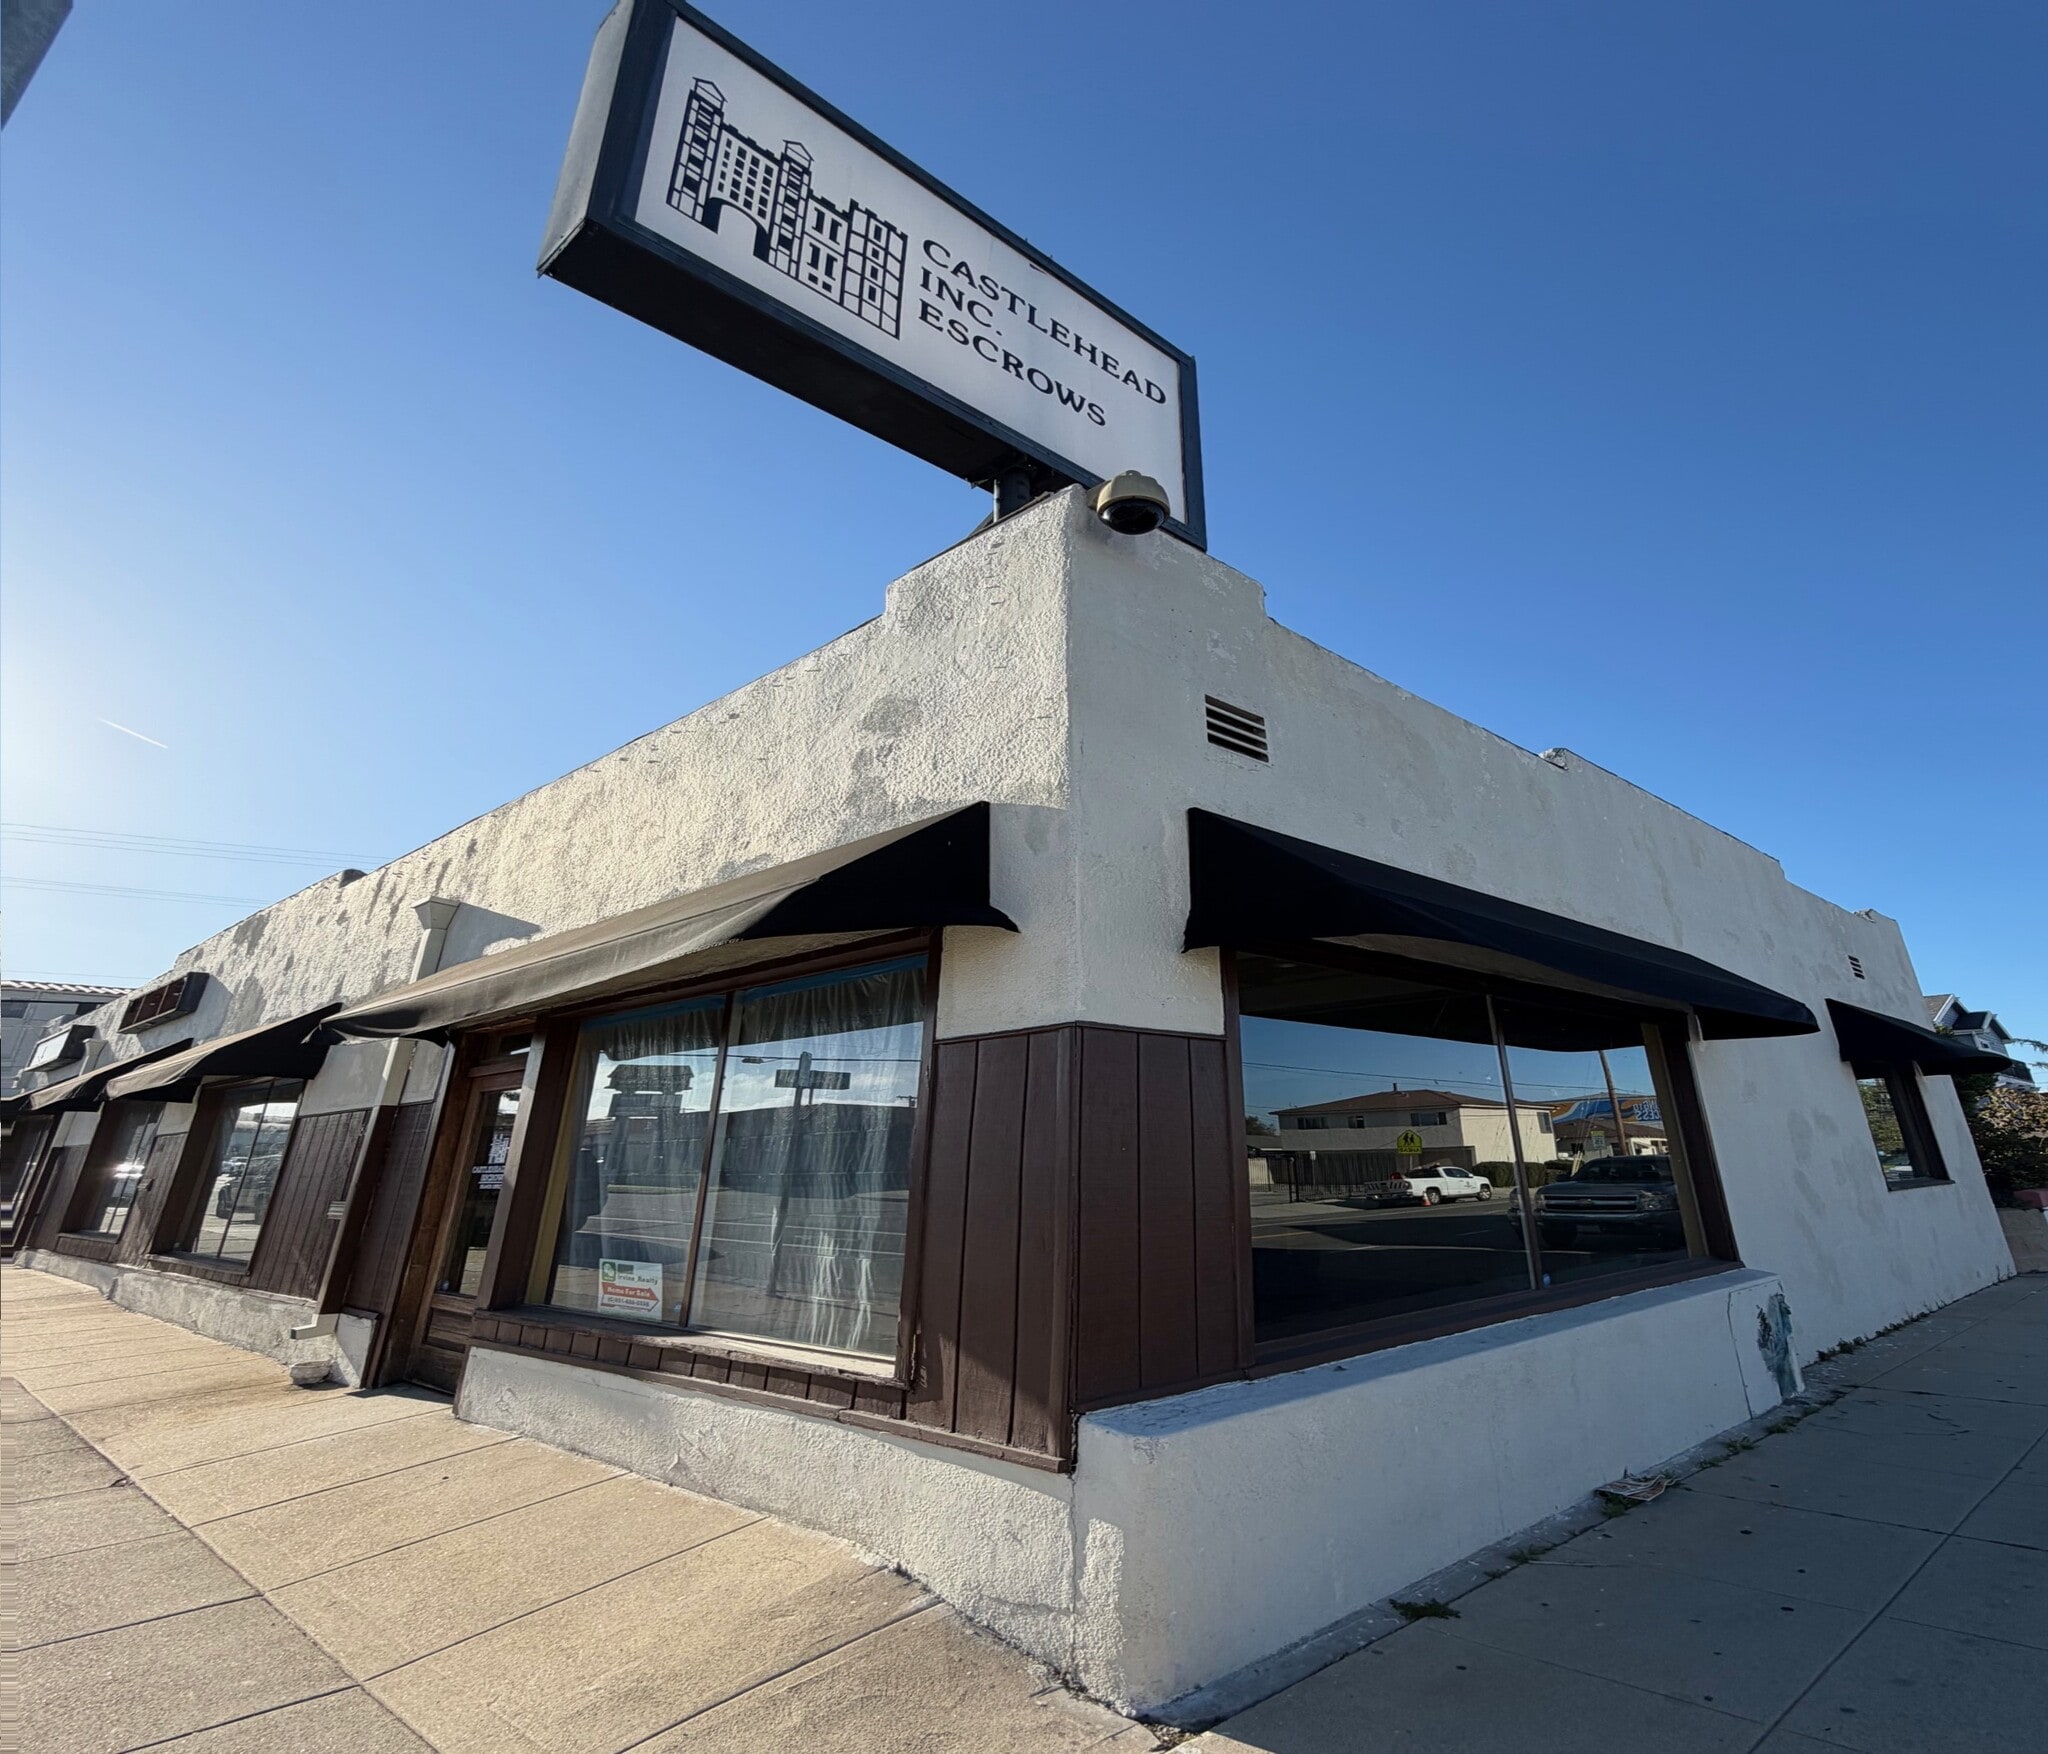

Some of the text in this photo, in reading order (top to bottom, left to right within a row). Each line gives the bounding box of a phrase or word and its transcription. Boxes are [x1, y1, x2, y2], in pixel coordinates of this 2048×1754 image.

[919, 298, 1106, 427] ESCROWS
[920, 266, 1002, 336] INC.
[923, 239, 1166, 404] CASTLEHEAD
